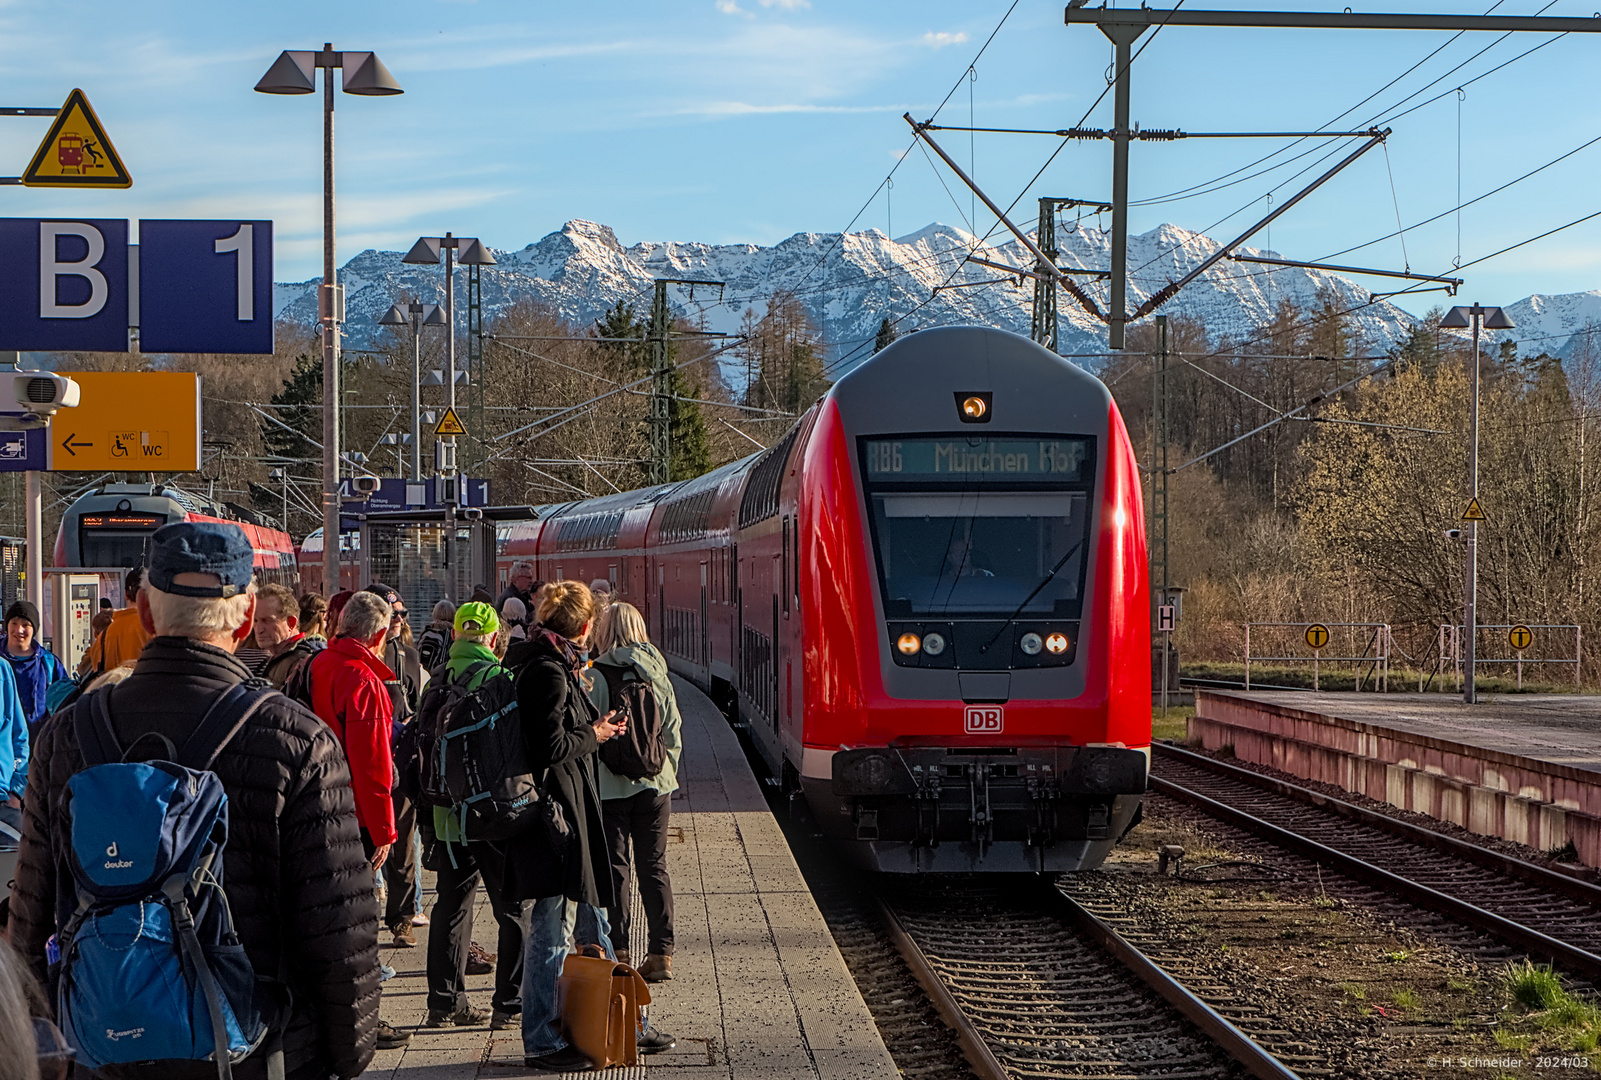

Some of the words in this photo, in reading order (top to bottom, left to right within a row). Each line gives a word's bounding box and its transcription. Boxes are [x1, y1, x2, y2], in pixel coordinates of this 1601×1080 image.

[40, 221, 108, 318] B
[214, 223, 254, 321] 1
[142, 445, 162, 456] WC
[935, 442, 1029, 472] München
[478, 482, 488, 505] 1
[1160, 607, 1174, 629] H
[970, 711, 999, 729] DB
[104, 860, 134, 868] deuter
